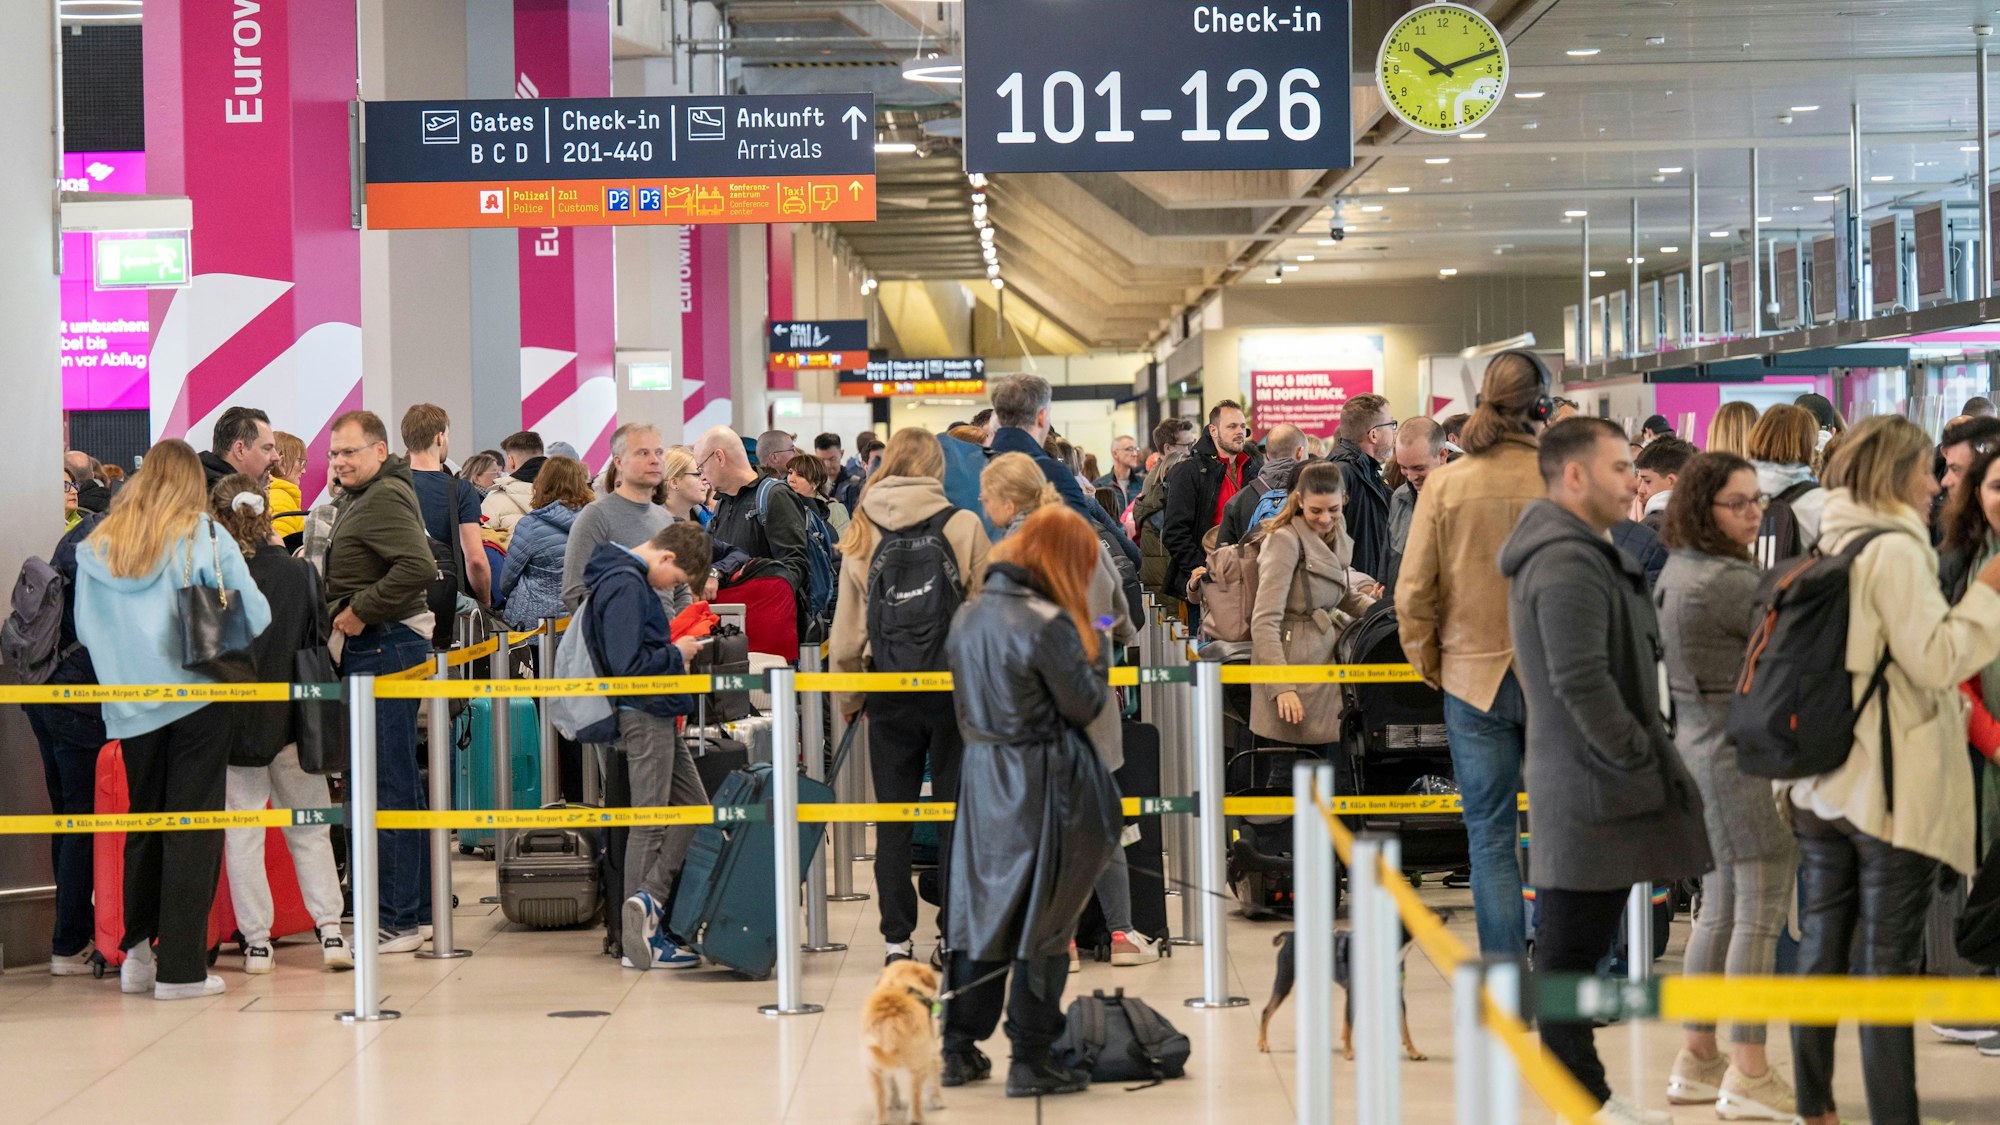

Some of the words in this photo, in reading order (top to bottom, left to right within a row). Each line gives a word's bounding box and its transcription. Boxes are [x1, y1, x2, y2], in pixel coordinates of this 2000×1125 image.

[1193, 4, 1322, 33] Check-in
[1437, 18, 1449, 28] 12
[1415, 26, 1426, 36] 11
[1463, 25, 1469, 35] 1
[1398, 42, 1410, 52] 10
[1479, 42, 1485, 52] 2
[1393, 65, 1400, 74] 9
[1486, 64, 1492, 74] 3
[1401, 87, 1407, 97] 8
[995, 68, 1322, 144] 101-126
[1416, 105, 1423, 115] 7
[1464, 105, 1470, 115] 5
[562, 110, 660, 131] Check-in
[737, 107, 825, 128] Ankunft
[1440, 111, 1447, 121] 6
[470, 112, 534, 132] Gates
[471, 143, 484, 163] B
[493, 143, 506, 163] C
[516, 142, 528, 163] D
[563, 141, 653, 163] 201-440
[737, 138, 822, 160] Arrivals
[729, 183, 770, 192] Konferenz-
[783, 186, 805, 196] Taxi
[514, 190, 549, 201] Polizei
[558, 190, 578, 200] Zoll
[729, 191, 761, 199] zentrum
[514, 203, 543, 213] Police
[558, 202, 599, 213] Customs
[729, 200, 769, 208] Conference
[87, 336, 107, 350] bis
[75, 355, 98, 367] vor
[101, 352, 147, 369] Abflug
[1256, 375, 1284, 387] FLUG
[1256, 389, 1271, 401] IM
[1273, 388, 1347, 401] DOPPELPACK.
[73, 688, 91, 697] Köln
[93, 688, 110, 697] Bonn
[112, 687, 139, 698] Airport
[191, 687, 208, 697] Köln
[210, 687, 227, 697] Bonn
[229, 686, 257, 697] Airport
[77, 818, 93, 828] Köln
[96, 818, 113, 828] Bonn
[115, 817, 142, 829] Airport
[194, 816, 211, 825] Köln
[213, 815, 230, 825] Bonn
[232, 814, 260, 826] Airport
